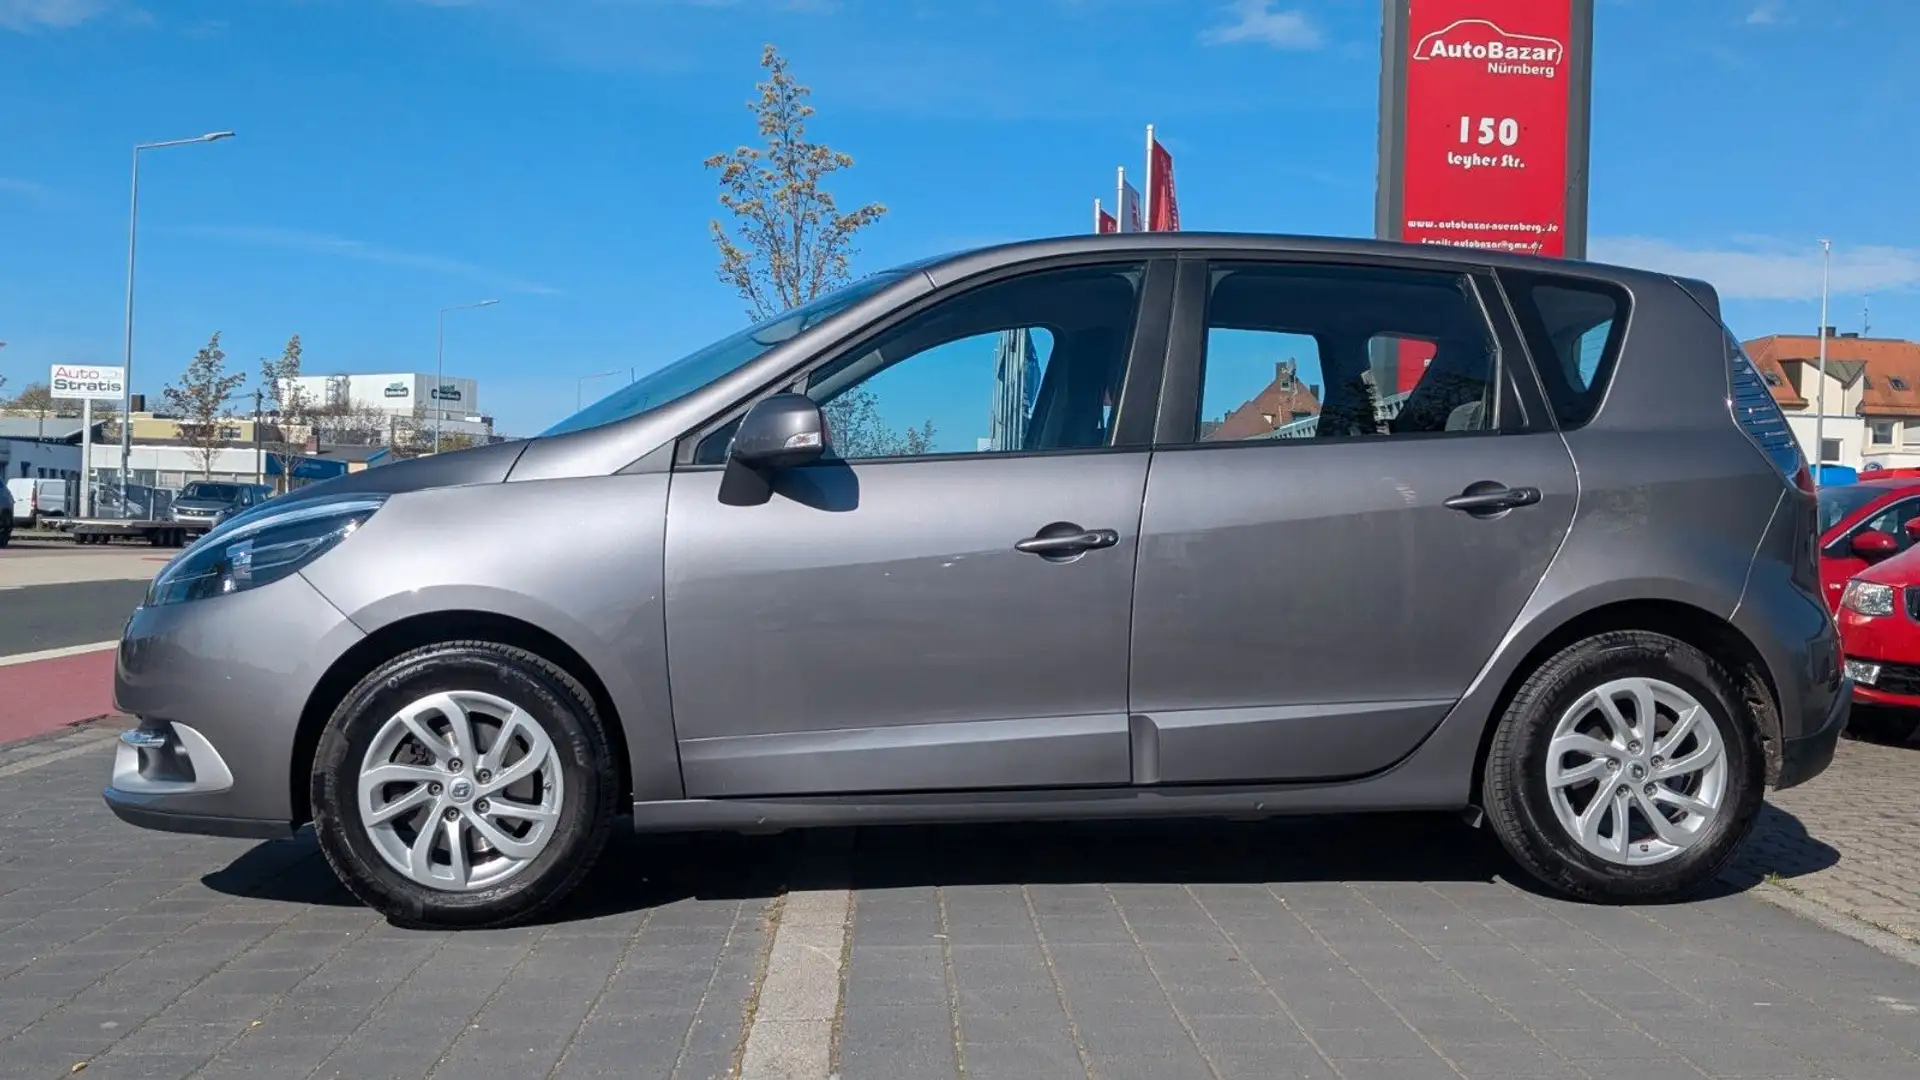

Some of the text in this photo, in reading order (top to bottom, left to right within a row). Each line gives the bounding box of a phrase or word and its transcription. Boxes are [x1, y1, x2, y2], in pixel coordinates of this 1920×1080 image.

[1430, 39, 1557, 61] AutoBazar
[1487, 62, 1555, 78] Nürnberg
[1459, 116, 1519, 146] 150
[1447, 151, 1526, 169] Leyher Str.
[54, 366, 100, 379] Auto
[54, 378, 122, 392] Stratis
